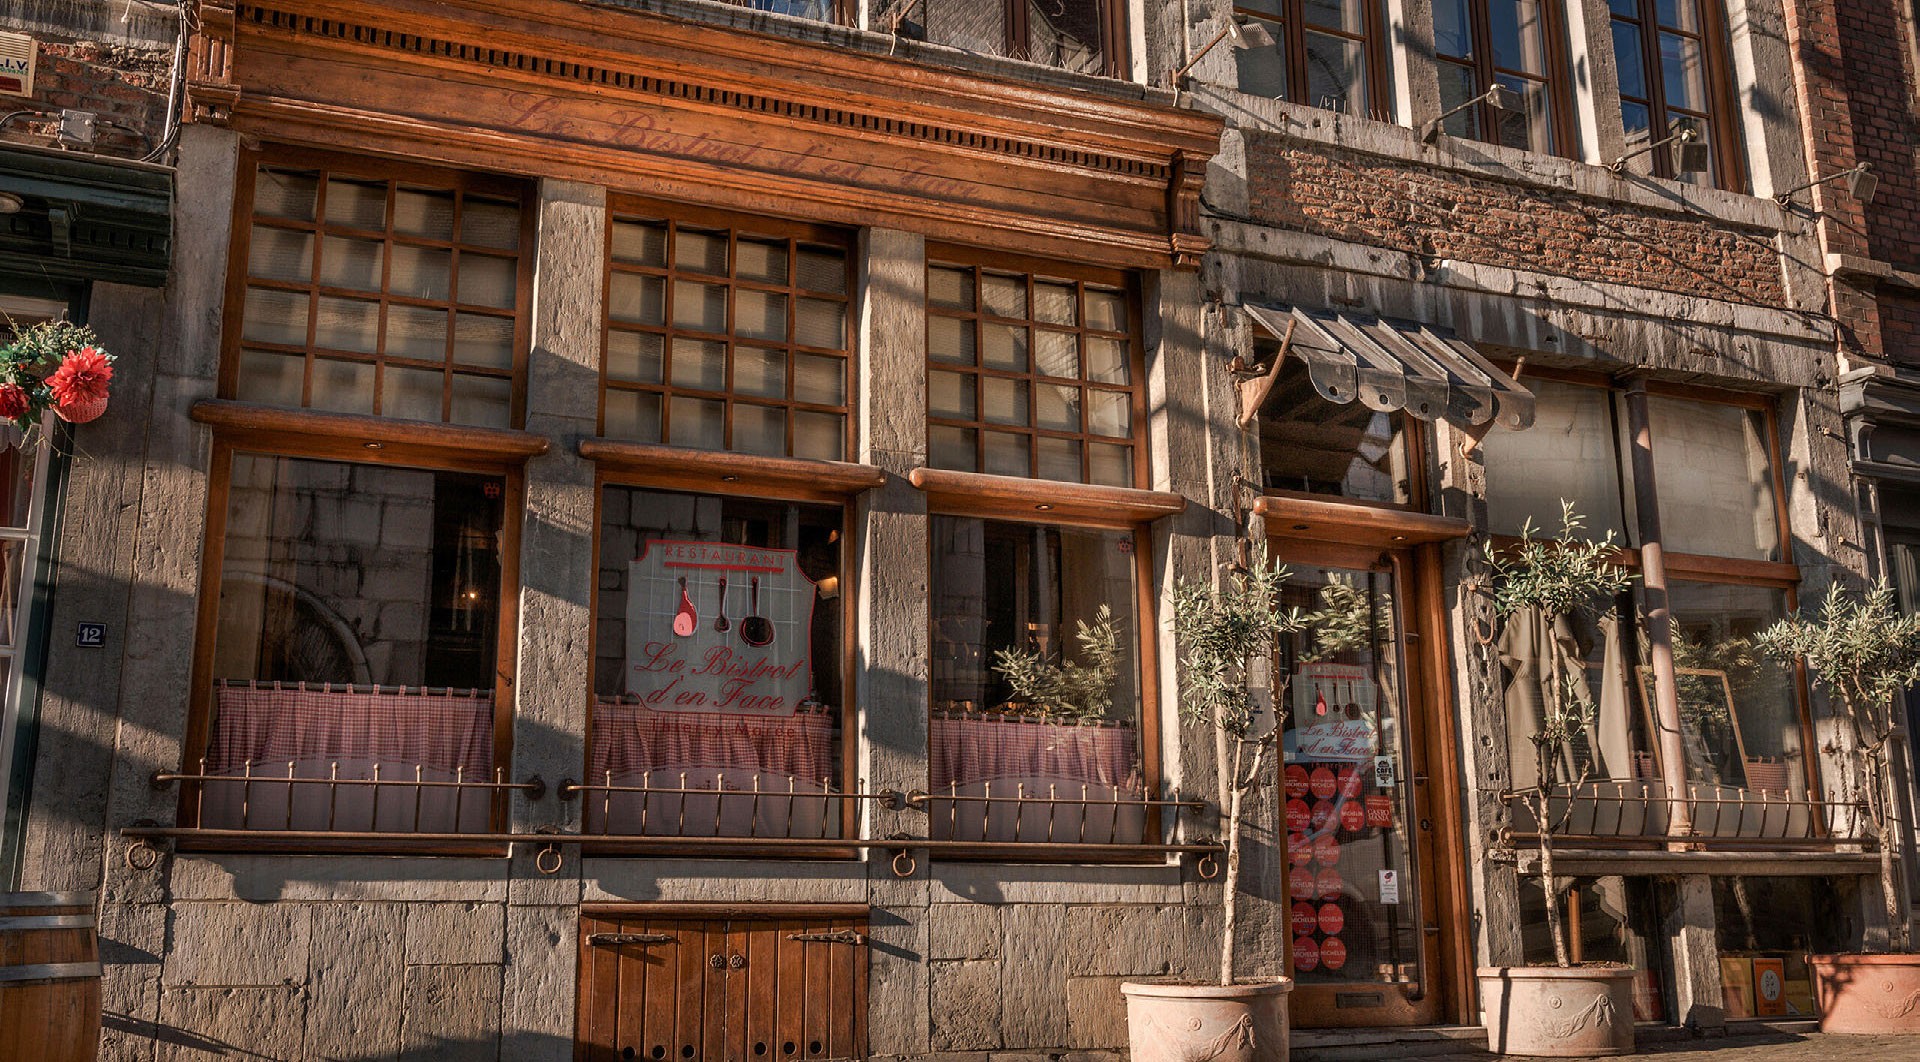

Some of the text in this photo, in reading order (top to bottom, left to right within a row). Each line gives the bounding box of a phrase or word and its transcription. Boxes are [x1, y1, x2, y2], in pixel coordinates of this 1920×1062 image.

[496, 91, 980, 199] Le Bistrot d'en Face
[665, 545, 785, 566] RESTAURANT
[81, 627, 101, 643] 12
[634, 641, 805, 681] Le Bistrot
[646, 674, 785, 710] d'en Face
[650, 716, 722, 737] Thierry
[1301, 719, 1325, 737] Le
